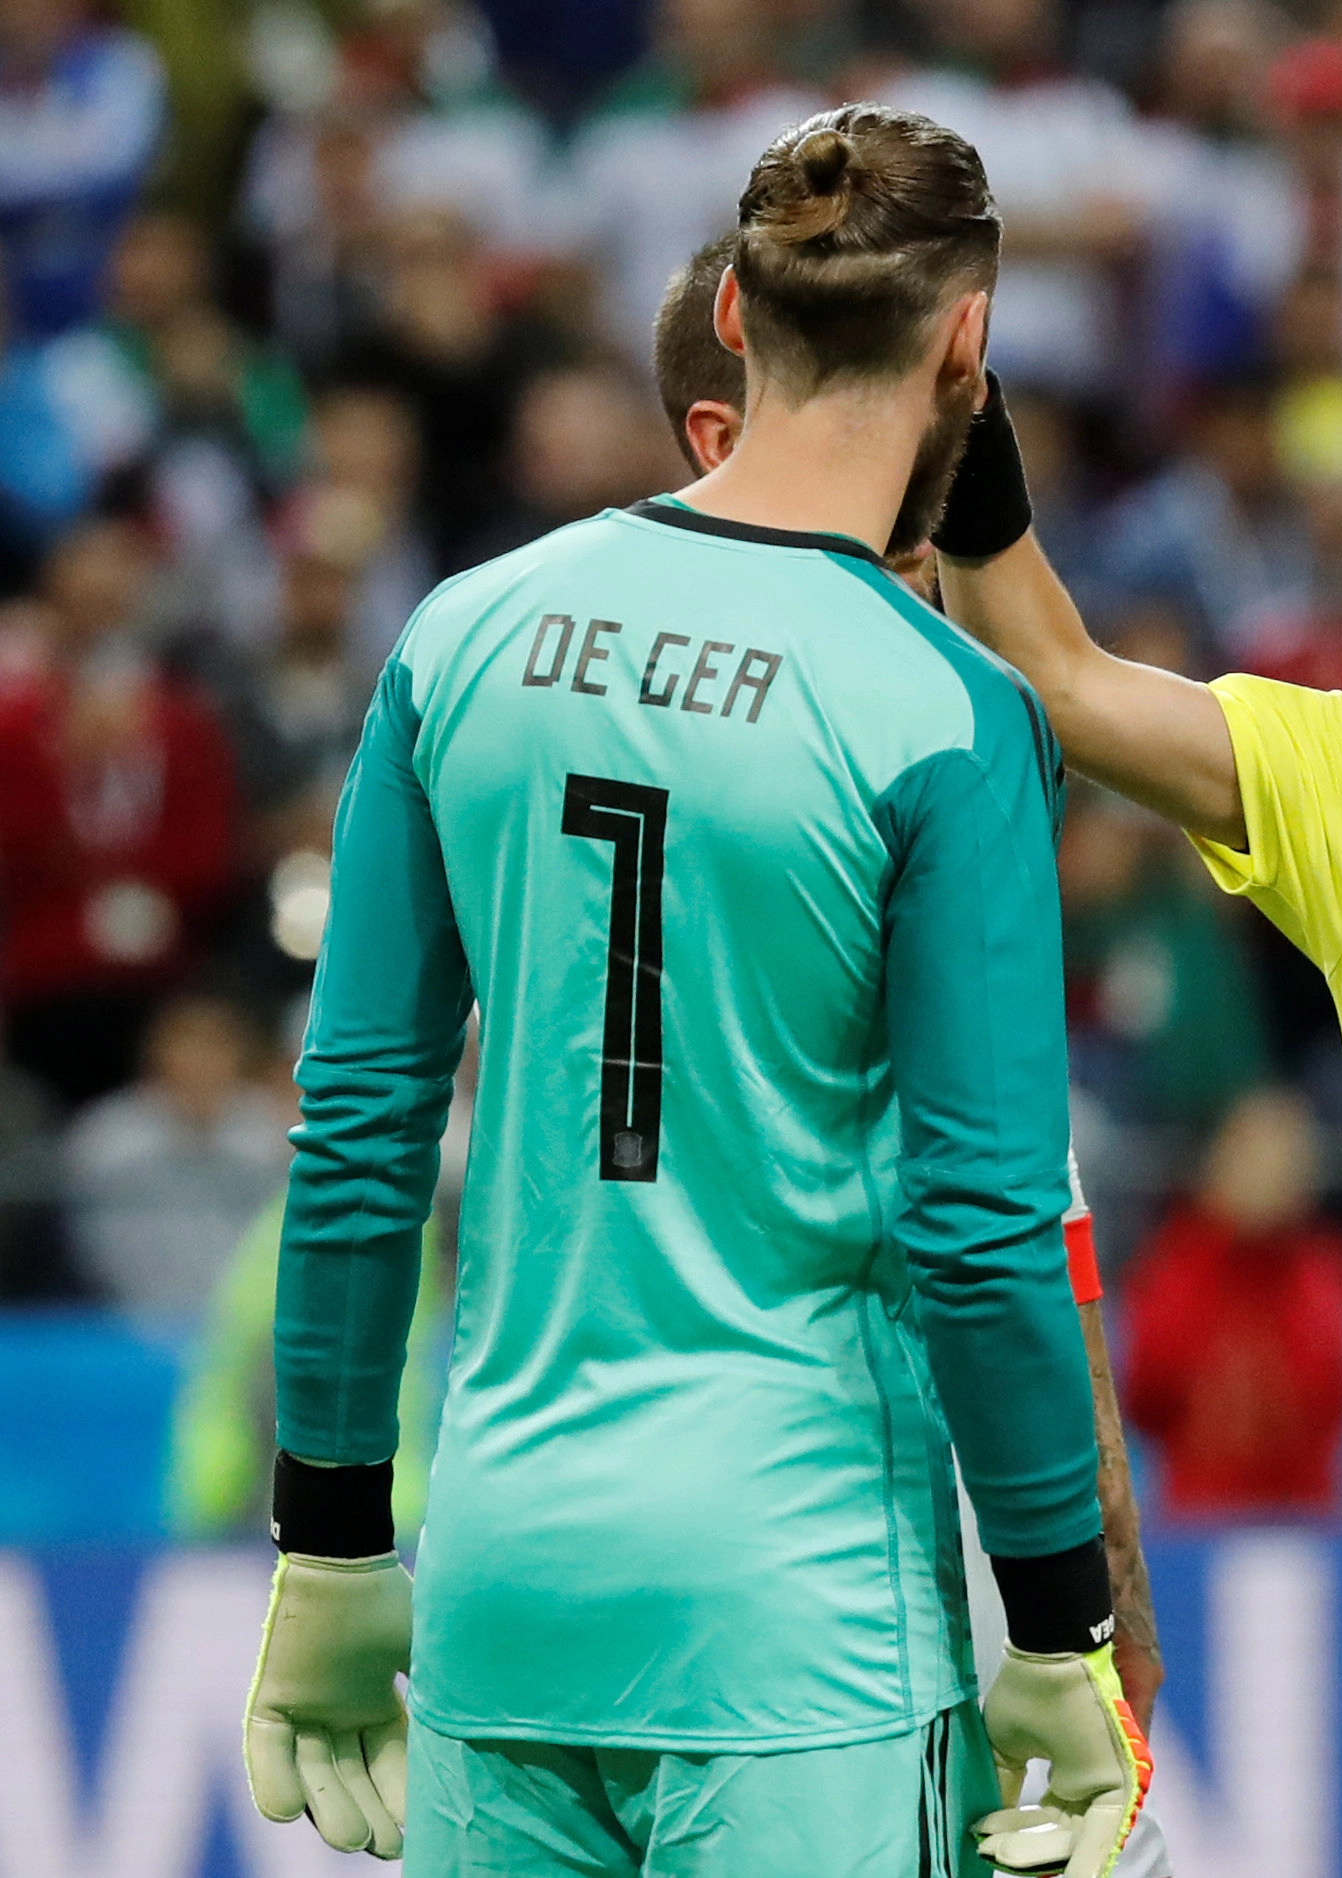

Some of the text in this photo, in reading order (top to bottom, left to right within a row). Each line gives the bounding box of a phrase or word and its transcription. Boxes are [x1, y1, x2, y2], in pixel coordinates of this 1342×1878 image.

[521, 613, 784, 724] DE GEA
[561, 772, 670, 1183] 1
